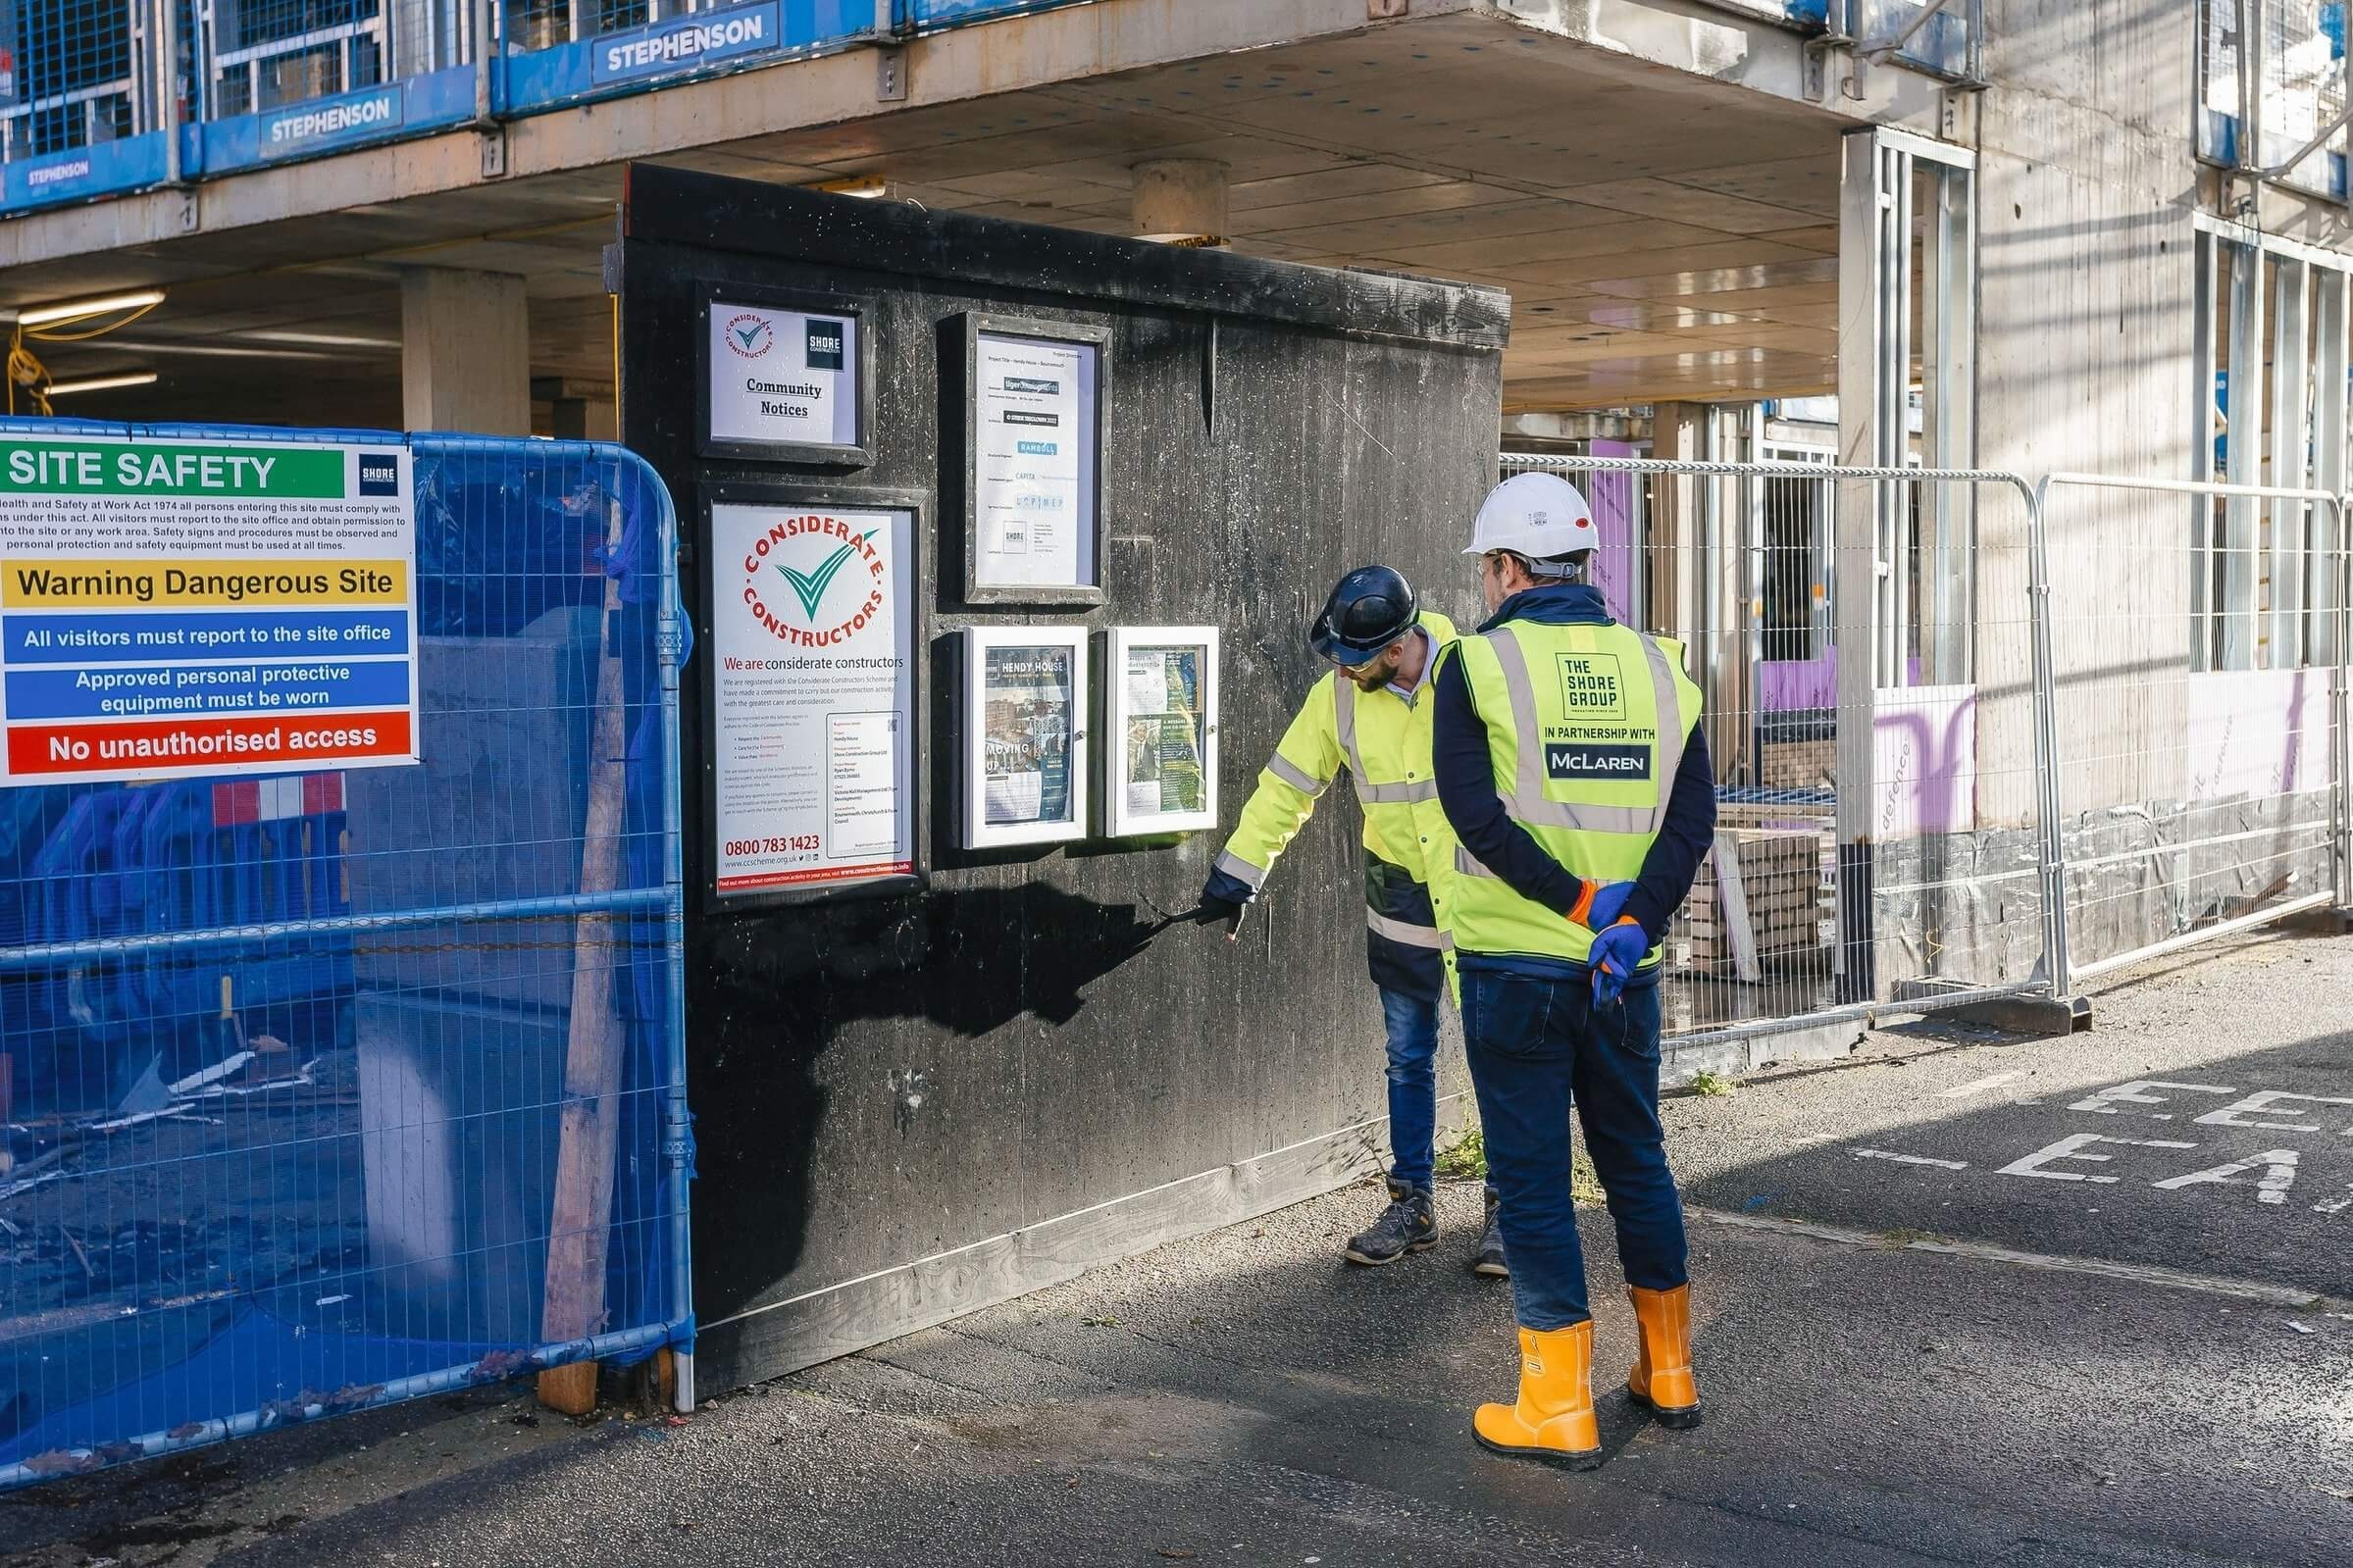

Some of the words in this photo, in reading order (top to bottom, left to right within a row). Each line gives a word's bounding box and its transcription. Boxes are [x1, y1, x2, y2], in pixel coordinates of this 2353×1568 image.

[607, 15, 762, 72] STEPHENSON
[272, 97, 390, 143] STEPHENSON
[28, 160, 89, 186] STEPHENSON
[809, 335, 841, 349] SHORE
[746, 379, 823, 400] Community
[760, 400, 809, 417] Notices
[8, 450, 104, 485] SITE
[117, 452, 277, 489] SAFETY
[363, 467, 394, 480] SHORE
[31, 500, 51, 509] and
[55, 500, 88, 512] Safety
[90, 501, 101, 510] at
[103, 501, 131, 510] Work
[133, 501, 151, 511] Act
[153, 502, 177, 511] 1974
[179, 502, 192, 511] all
[194, 502, 234, 514] persons
[237, 503, 277, 515] entering
[280, 503, 298, 513] this
[300, 504, 317, 513] site
[320, 504, 343, 513] must
[345, 504, 379, 516] comply
[381, 505, 400, 514] with
[12, 514, 45, 523] under
[47, 514, 67, 523] this
[70, 514, 89, 523] act.
[92, 514, 106, 524] All
[108, 515, 147, 524] visitors
[149, 515, 175, 524] must
[179, 515, 208, 527] report
[212, 515, 221, 525] to
[224, 515, 239, 525] the
[242, 516, 259, 525] site
[262, 516, 288, 525] office
[291, 516, 309, 525] and
[312, 516, 341, 526] obtain
[343, 517, 394, 528] permission
[396, 517, 406, 526] to
[18, 527, 35, 535] the
[38, 527, 57, 535] site
[61, 527, 73, 536] or
[75, 528, 93, 538] any
[96, 528, 122, 536] work
[126, 528, 150, 536] area.
[153, 528, 184, 539] Safety
[187, 528, 214, 539] signs
[218, 528, 235, 537] and
[238, 529, 292, 539] procedures
[296, 529, 320, 537] must
[322, 529, 333, 537] be
[335, 529, 379, 537] observed
[381, 529, 398, 538] and
[6, 540, 53, 551] personal
[57, 540, 110, 551] protection
[114, 540, 133, 549] and
[135, 540, 167, 551] safety
[169, 540, 223, 552] equipment
[224, 540, 249, 549] must
[251, 540, 263, 549] be
[267, 540, 289, 550] used
[292, 540, 302, 550] at
[304, 540, 314, 550] all
[318, 540, 345, 550] times.
[744, 515, 884, 578] CONSIDERATE
[17, 569, 155, 602] Warning
[165, 569, 330, 600] Dangerous
[338, 569, 393, 593] Site
[743, 587, 883, 647] CONSTRUCTORS
[24, 630, 51, 647] All
[57, 630, 130, 647] visitors
[136, 630, 184, 645] must
[189, 629, 245, 649] report
[251, 629, 269, 643] to
[273, 628, 302, 642] the
[306, 627, 338, 641] site
[342, 625, 392, 641] office
[724, 657, 742, 671] We
[744, 660, 764, 671] are
[765, 656, 833, 670] considerate
[835, 656, 903, 669] constructors
[1002, 662, 1032, 673] HENDY
[1035, 661, 1063, 673] HOUSE
[1564, 660, 1591, 674] THE
[76, 669, 171, 690] Approved
[177, 666, 257, 688] personal
[262, 664, 350, 683] protective
[1567, 676, 1616, 690] SHORE
[100, 693, 203, 714] equipment
[207, 691, 254, 708] must
[259, 690, 281, 706] be
[285, 691, 330, 705] worn
[1569, 691, 1617, 707] GROUP
[1545, 727, 1556, 738] IN
[1558, 727, 1628, 739] PARTNERSHIP
[1630, 728, 1656, 740] WITH
[48, 735, 90, 761] No
[99, 727, 281, 758] unauthorised
[288, 727, 378, 749] access
[987, 743, 1030, 755] MOVING
[1882, 743, 1910, 832] defence
[726, 839, 760, 857] 0800
[762, 837, 788, 854] 783
[791, 835, 820, 851] 1423
[724, 854, 796, 869] www.ccscheme.org.uk
